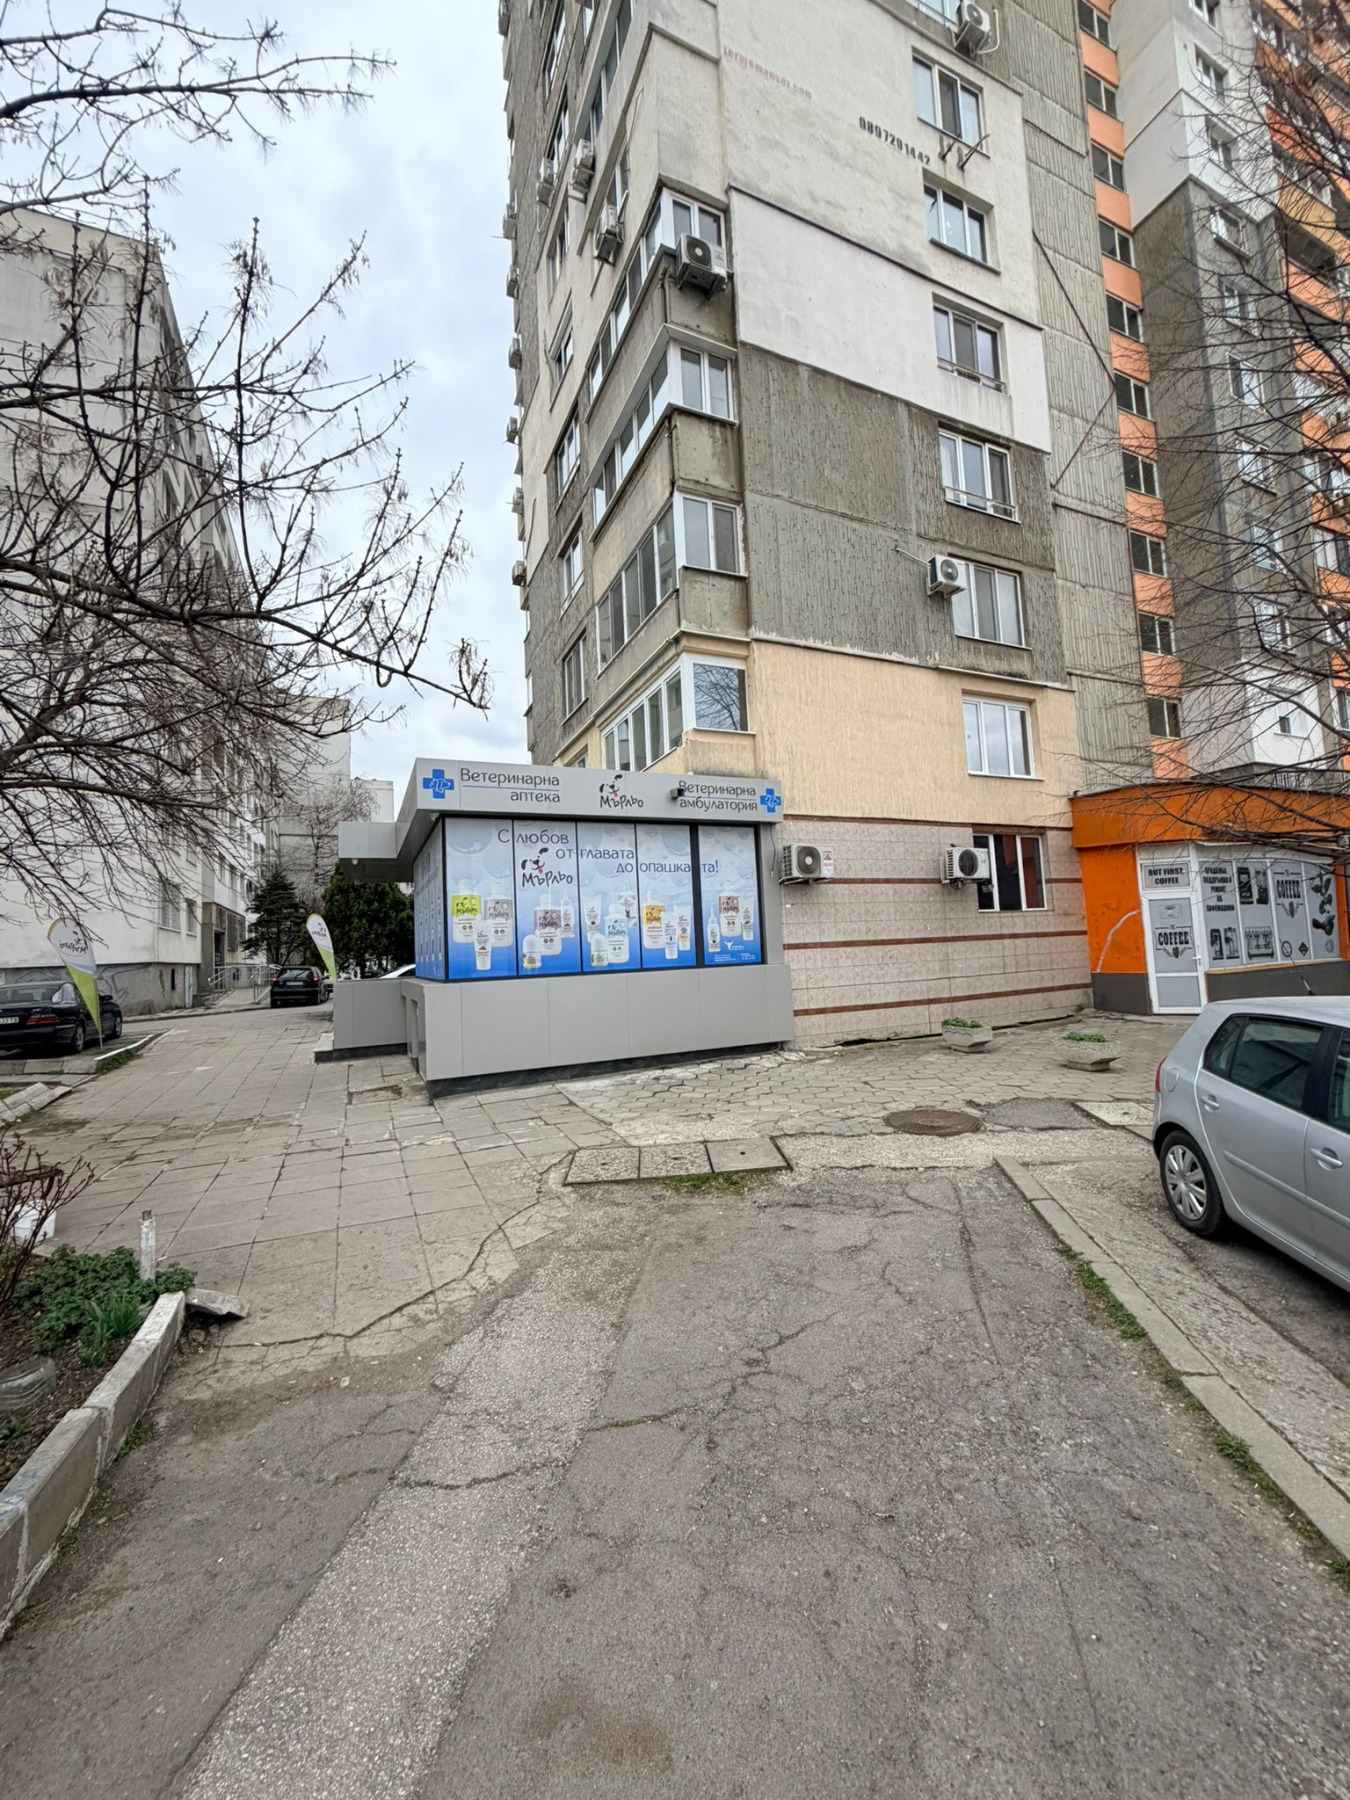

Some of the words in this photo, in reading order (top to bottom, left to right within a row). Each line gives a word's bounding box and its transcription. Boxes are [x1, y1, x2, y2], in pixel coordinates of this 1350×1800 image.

[859, 116, 931, 166] 0897201442
[460, 767, 560, 788] Ветеринарна
[510, 790, 560, 803] аптека
[678, 780, 756, 798] Ветеринарна
[679, 796, 758, 813] амбулатория
[498, 828, 511, 843] С
[516, 829, 569, 844] любов
[555, 848, 573, 859] от
[580, 849, 635, 860] главата
[616, 863, 634, 874] до
[1148, 868, 1162, 876] BUT
[1154, 877, 1179, 885] COFFEE
[1276, 880, 1301, 899] COFFEE
[1158, 931, 1190, 946] COFFEE
